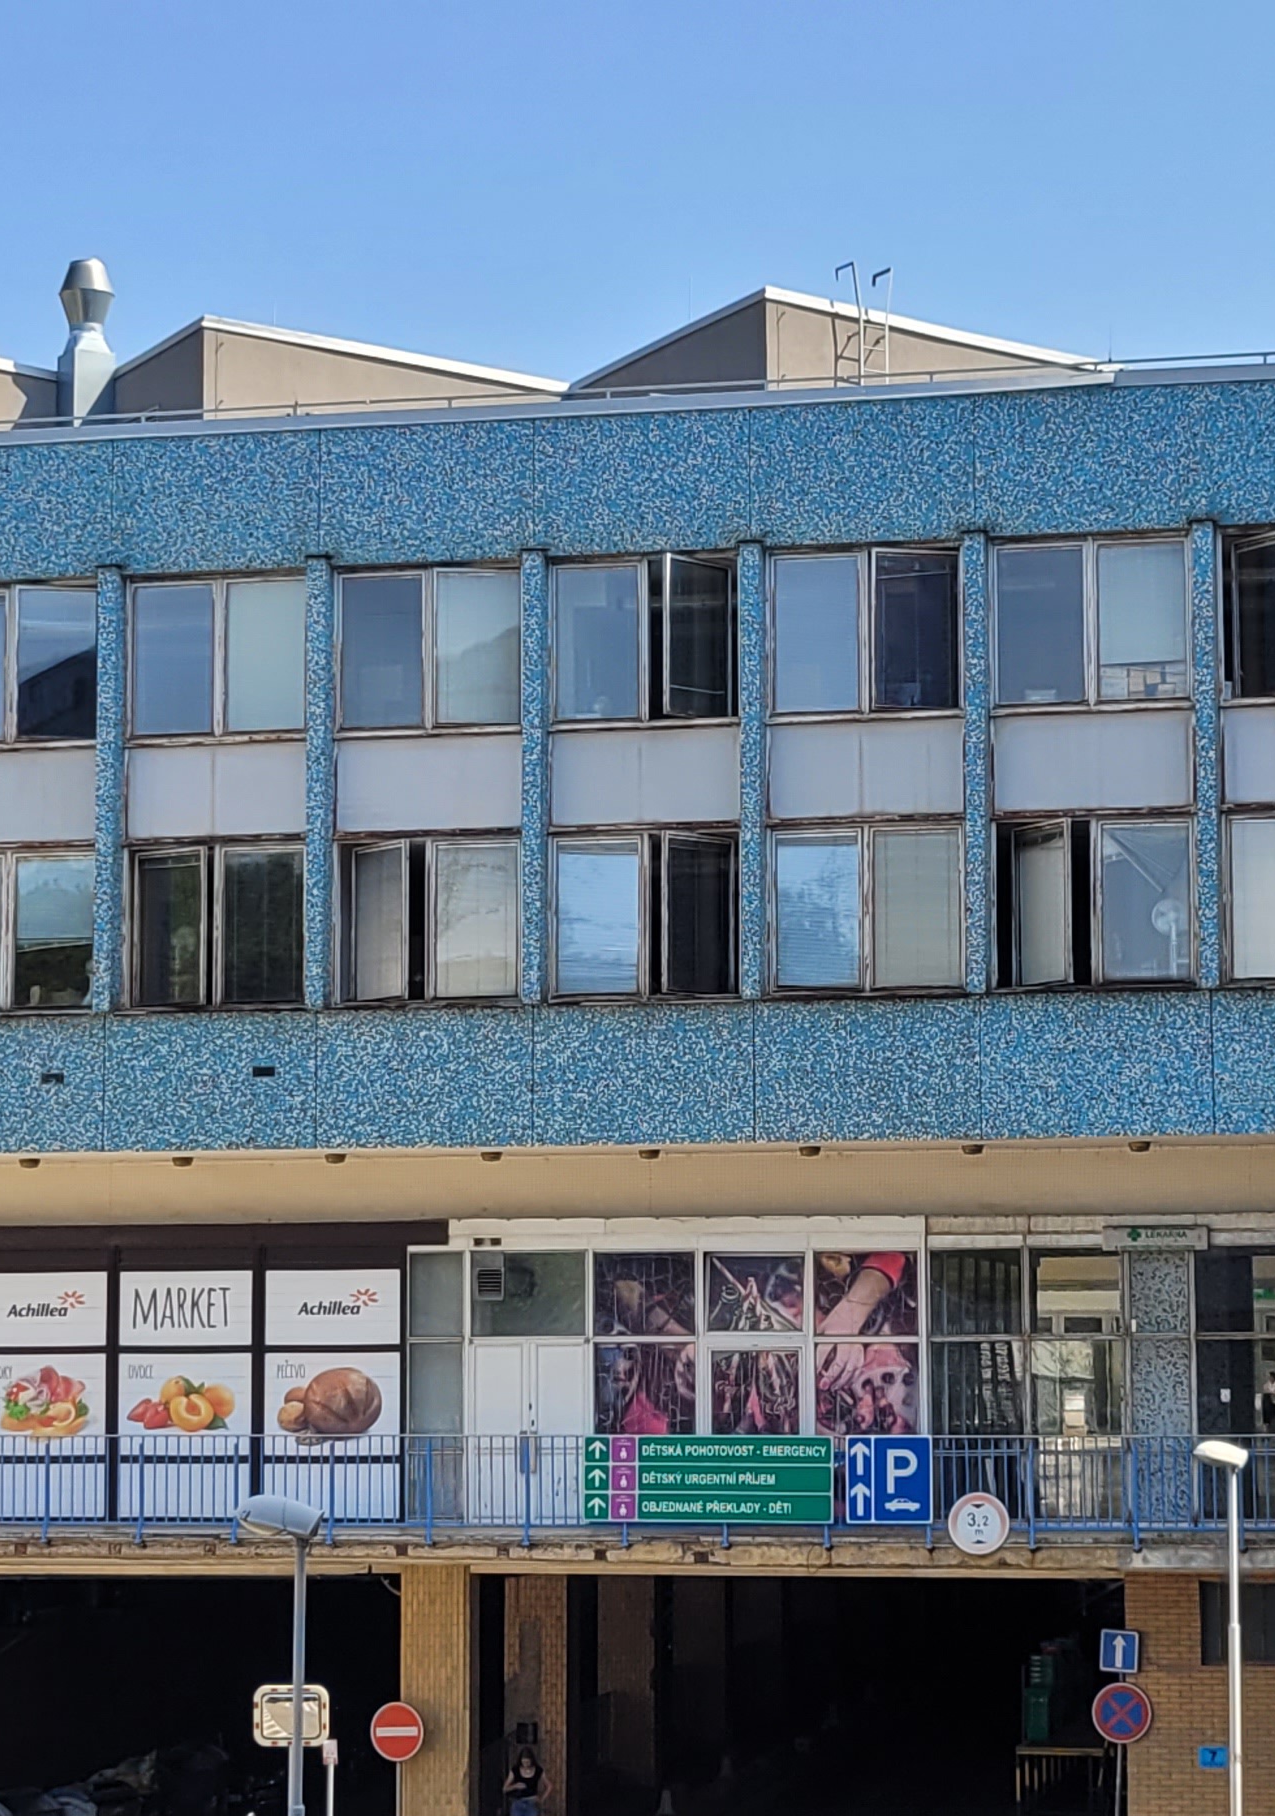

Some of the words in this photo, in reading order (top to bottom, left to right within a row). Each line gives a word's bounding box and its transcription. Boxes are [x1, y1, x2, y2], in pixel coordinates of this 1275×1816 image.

[7, 1303, 68, 1318] Achillea
[132, 1287, 231, 1331] MARKET
[297, 1300, 361, 1316] Achillea
[128, 1364, 154, 1379] OVOCE
[276, 1359, 306, 1379] PEČIVO
[641, 1443, 682, 1456] DĚTSKÁ
[685, 1445, 754, 1457] POHOTOVOST
[762, 1445, 827, 1458] EMERGENCY
[641, 1471, 682, 1485] DĚTSKÝ
[684, 1473, 737, 1485] URGENTNÍ
[738, 1472, 776, 1486] PŘÍJEM
[886, 1448, 918, 1494] P
[641, 1500, 704, 1514] OBJEDNANÉ
[706, 1501, 760, 1515] PŘEKLADY
[768, 1502, 792, 1515] DĚTI
[1209, 1749, 1218, 1761] 7
